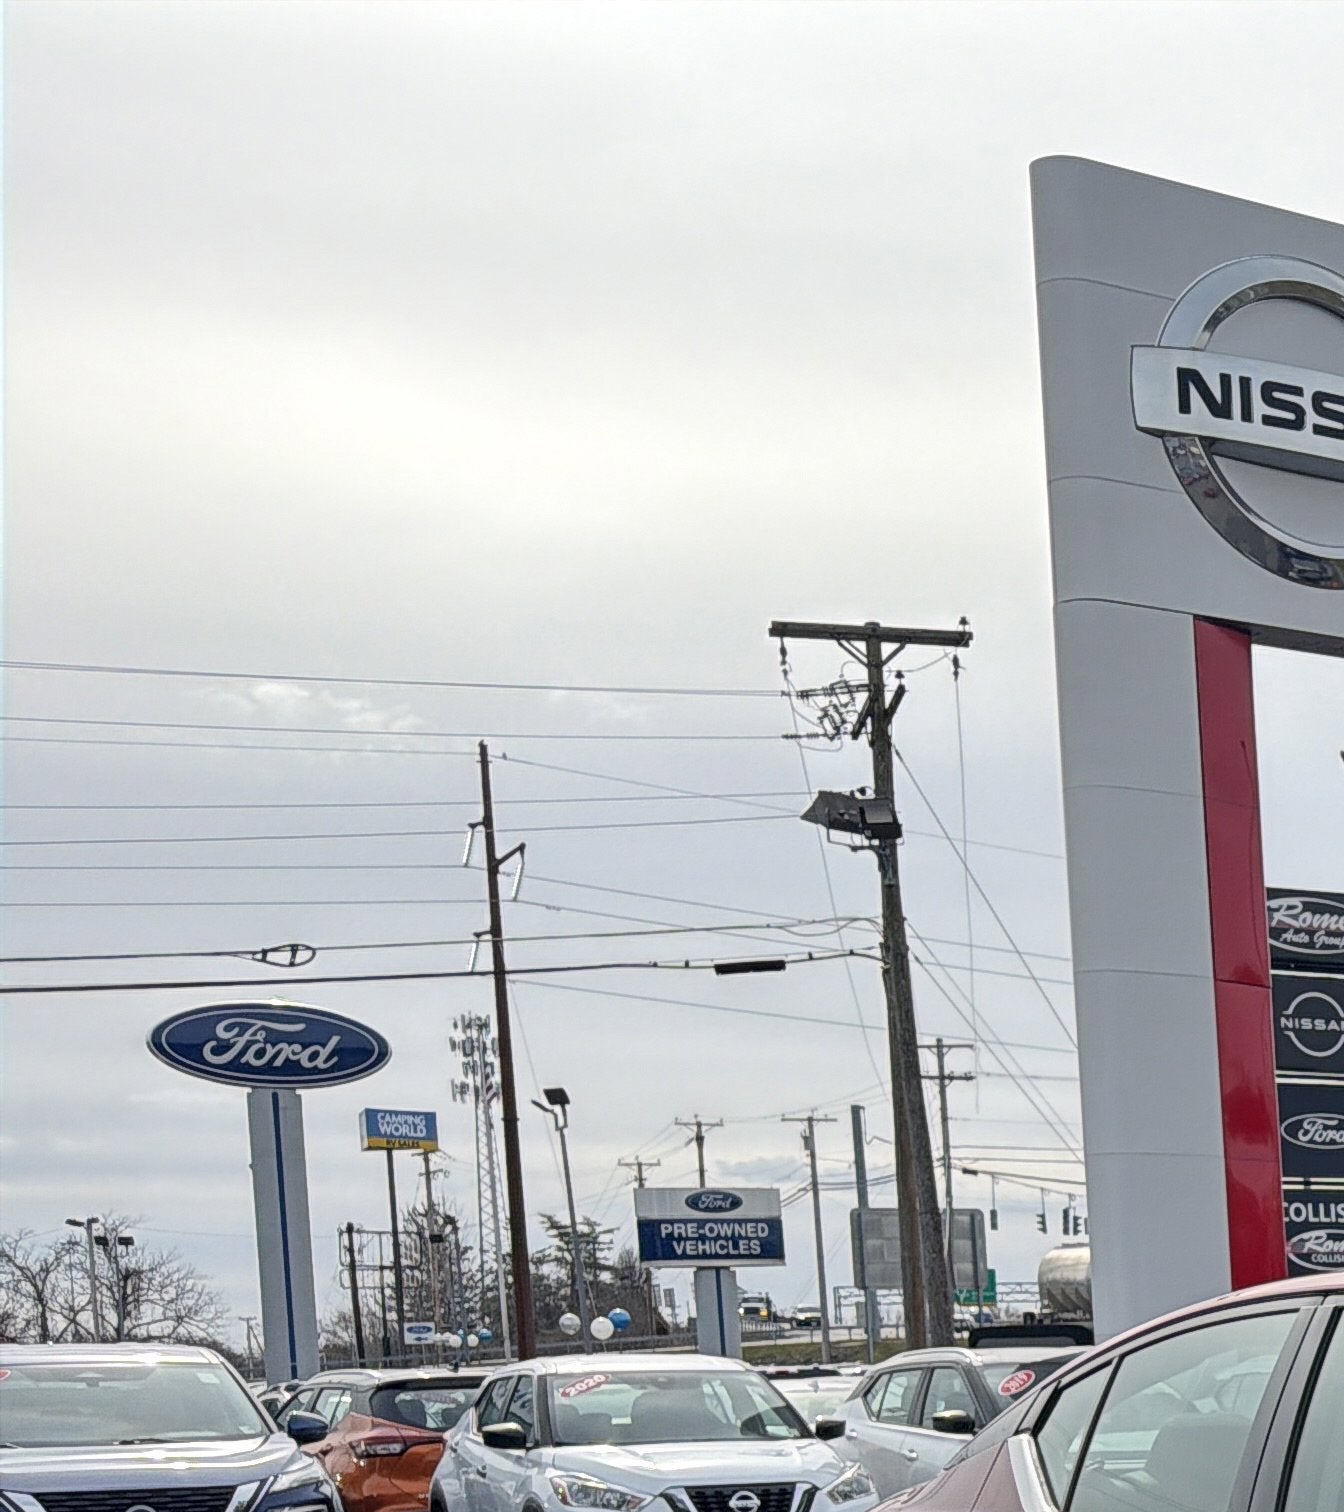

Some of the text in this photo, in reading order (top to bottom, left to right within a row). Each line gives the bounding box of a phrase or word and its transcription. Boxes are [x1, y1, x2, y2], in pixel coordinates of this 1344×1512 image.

[1280, 929, 1310, 943] Auto
[200, 1017, 343, 1070] Ford
[377, 1112, 426, 1125] CAMPING
[378, 1121, 427, 1138] WORLD
[698, 1194, 732, 1209] Ford
[660, 1222, 769, 1239] PRE-OWNED
[672, 1240, 761, 1255] VEHICLES
[565, 1375, 607, 1397] 2020
